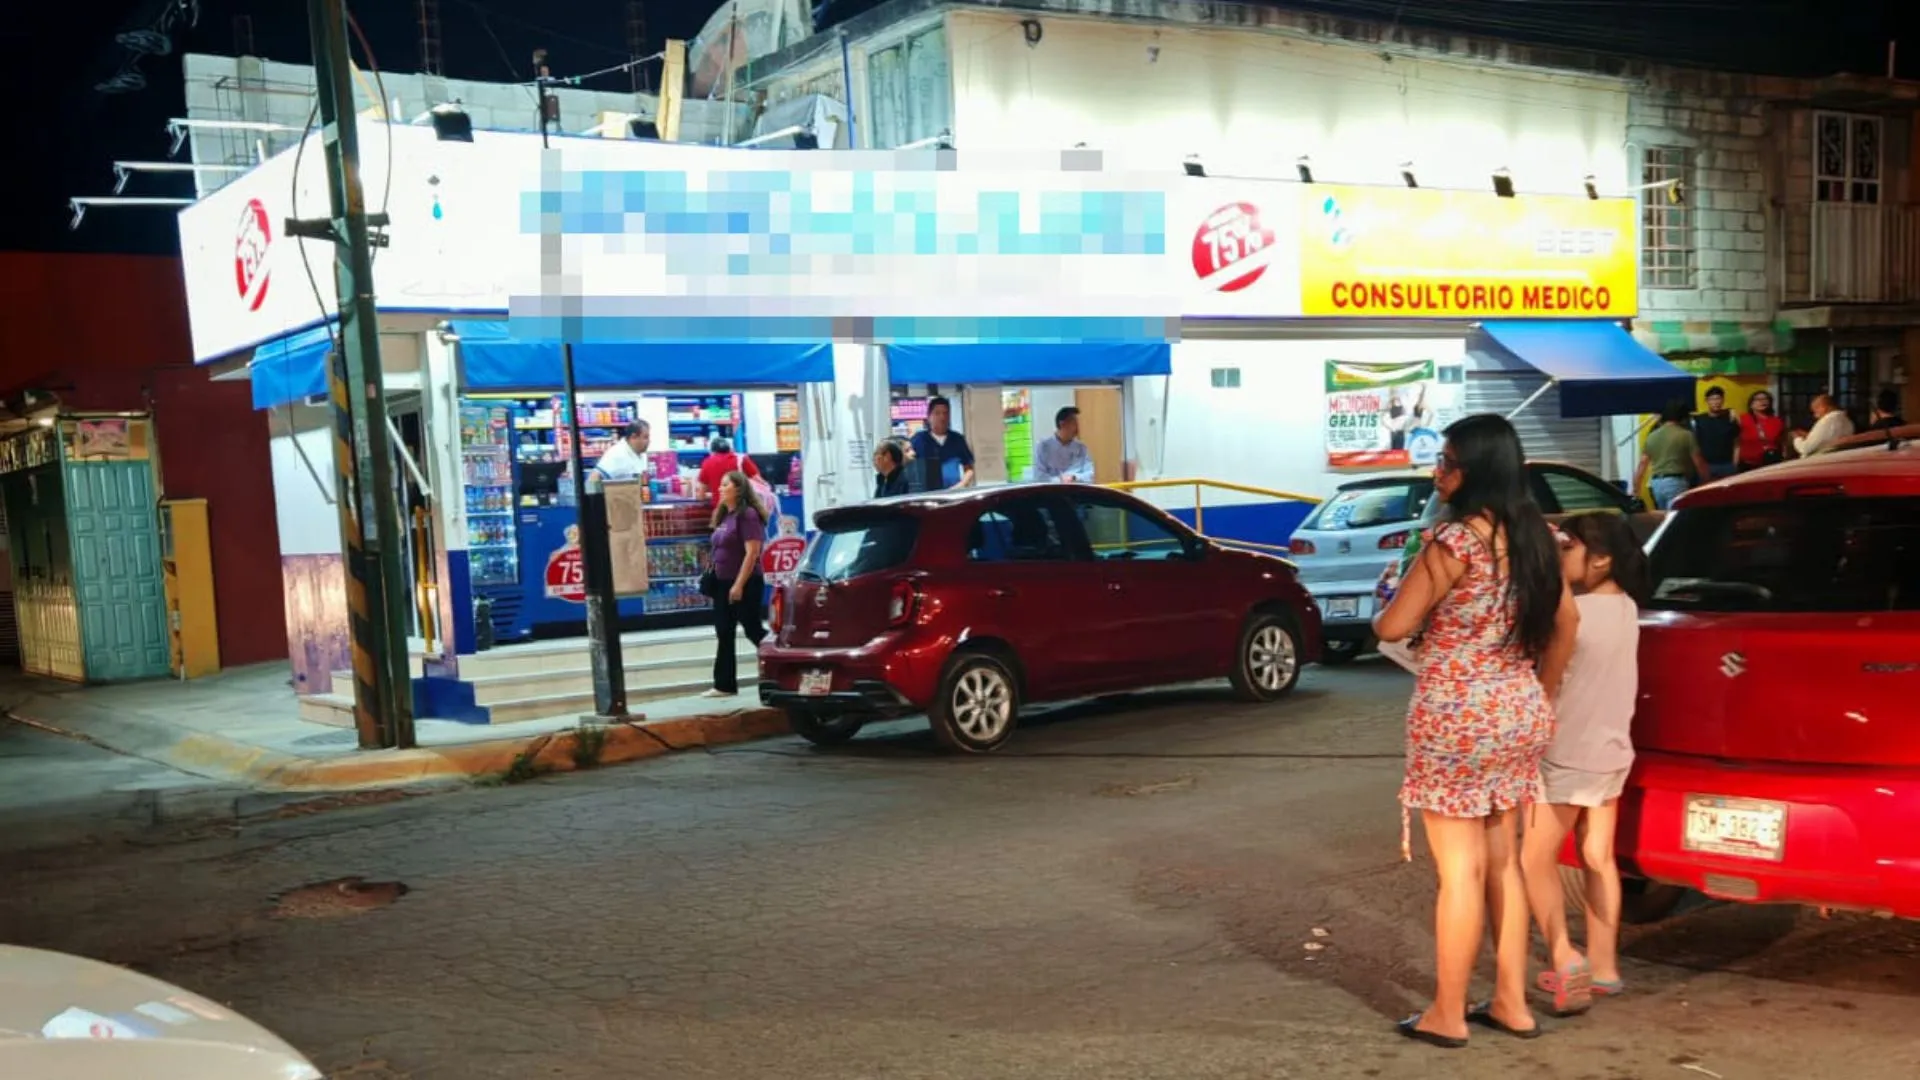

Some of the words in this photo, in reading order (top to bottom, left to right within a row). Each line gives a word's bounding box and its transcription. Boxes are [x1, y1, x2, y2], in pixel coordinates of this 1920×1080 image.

[1201, 217, 1264, 269] 75%
[1331, 281, 1514, 310] CONSULTORIO
[1522, 285, 1611, 311] MEDICO
[1328, 413, 1378, 428] GRATIS
